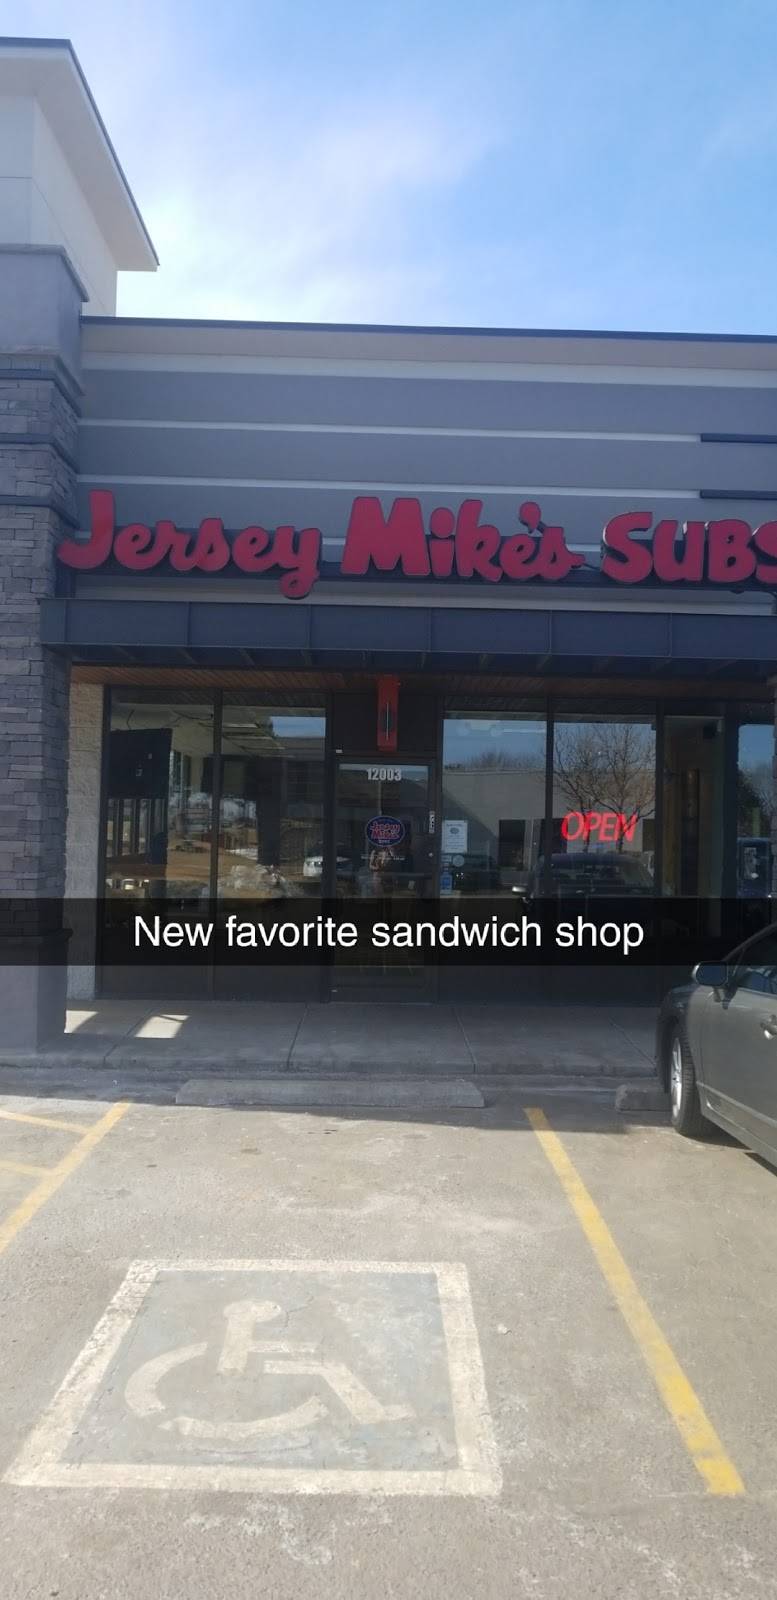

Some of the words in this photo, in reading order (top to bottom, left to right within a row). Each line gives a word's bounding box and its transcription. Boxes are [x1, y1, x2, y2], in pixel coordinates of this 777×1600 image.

[58, 489, 322, 599] Jersey
[341, 496, 586, 582] Mike's
[367, 767, 402, 781] 12003
[561, 811, 637, 842] OPEN
